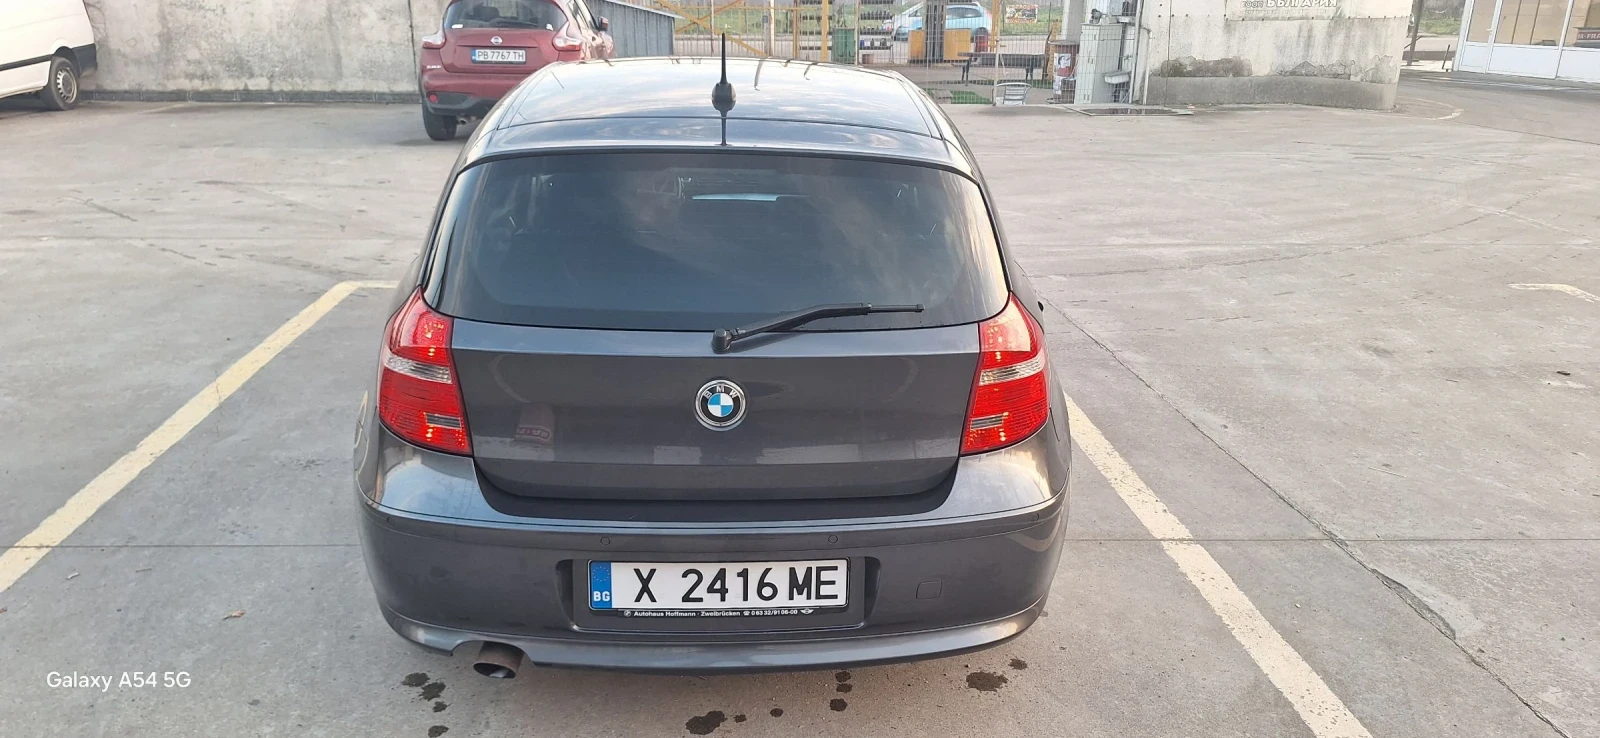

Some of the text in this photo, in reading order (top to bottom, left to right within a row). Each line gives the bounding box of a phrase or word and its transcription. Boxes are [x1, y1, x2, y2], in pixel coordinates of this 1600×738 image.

[477, 50, 525, 60] PB 7767 TH
[703, 385, 738, 399] BMW
[633, 566, 839, 603] X 2416 ME
[593, 591, 611, 602] BG
